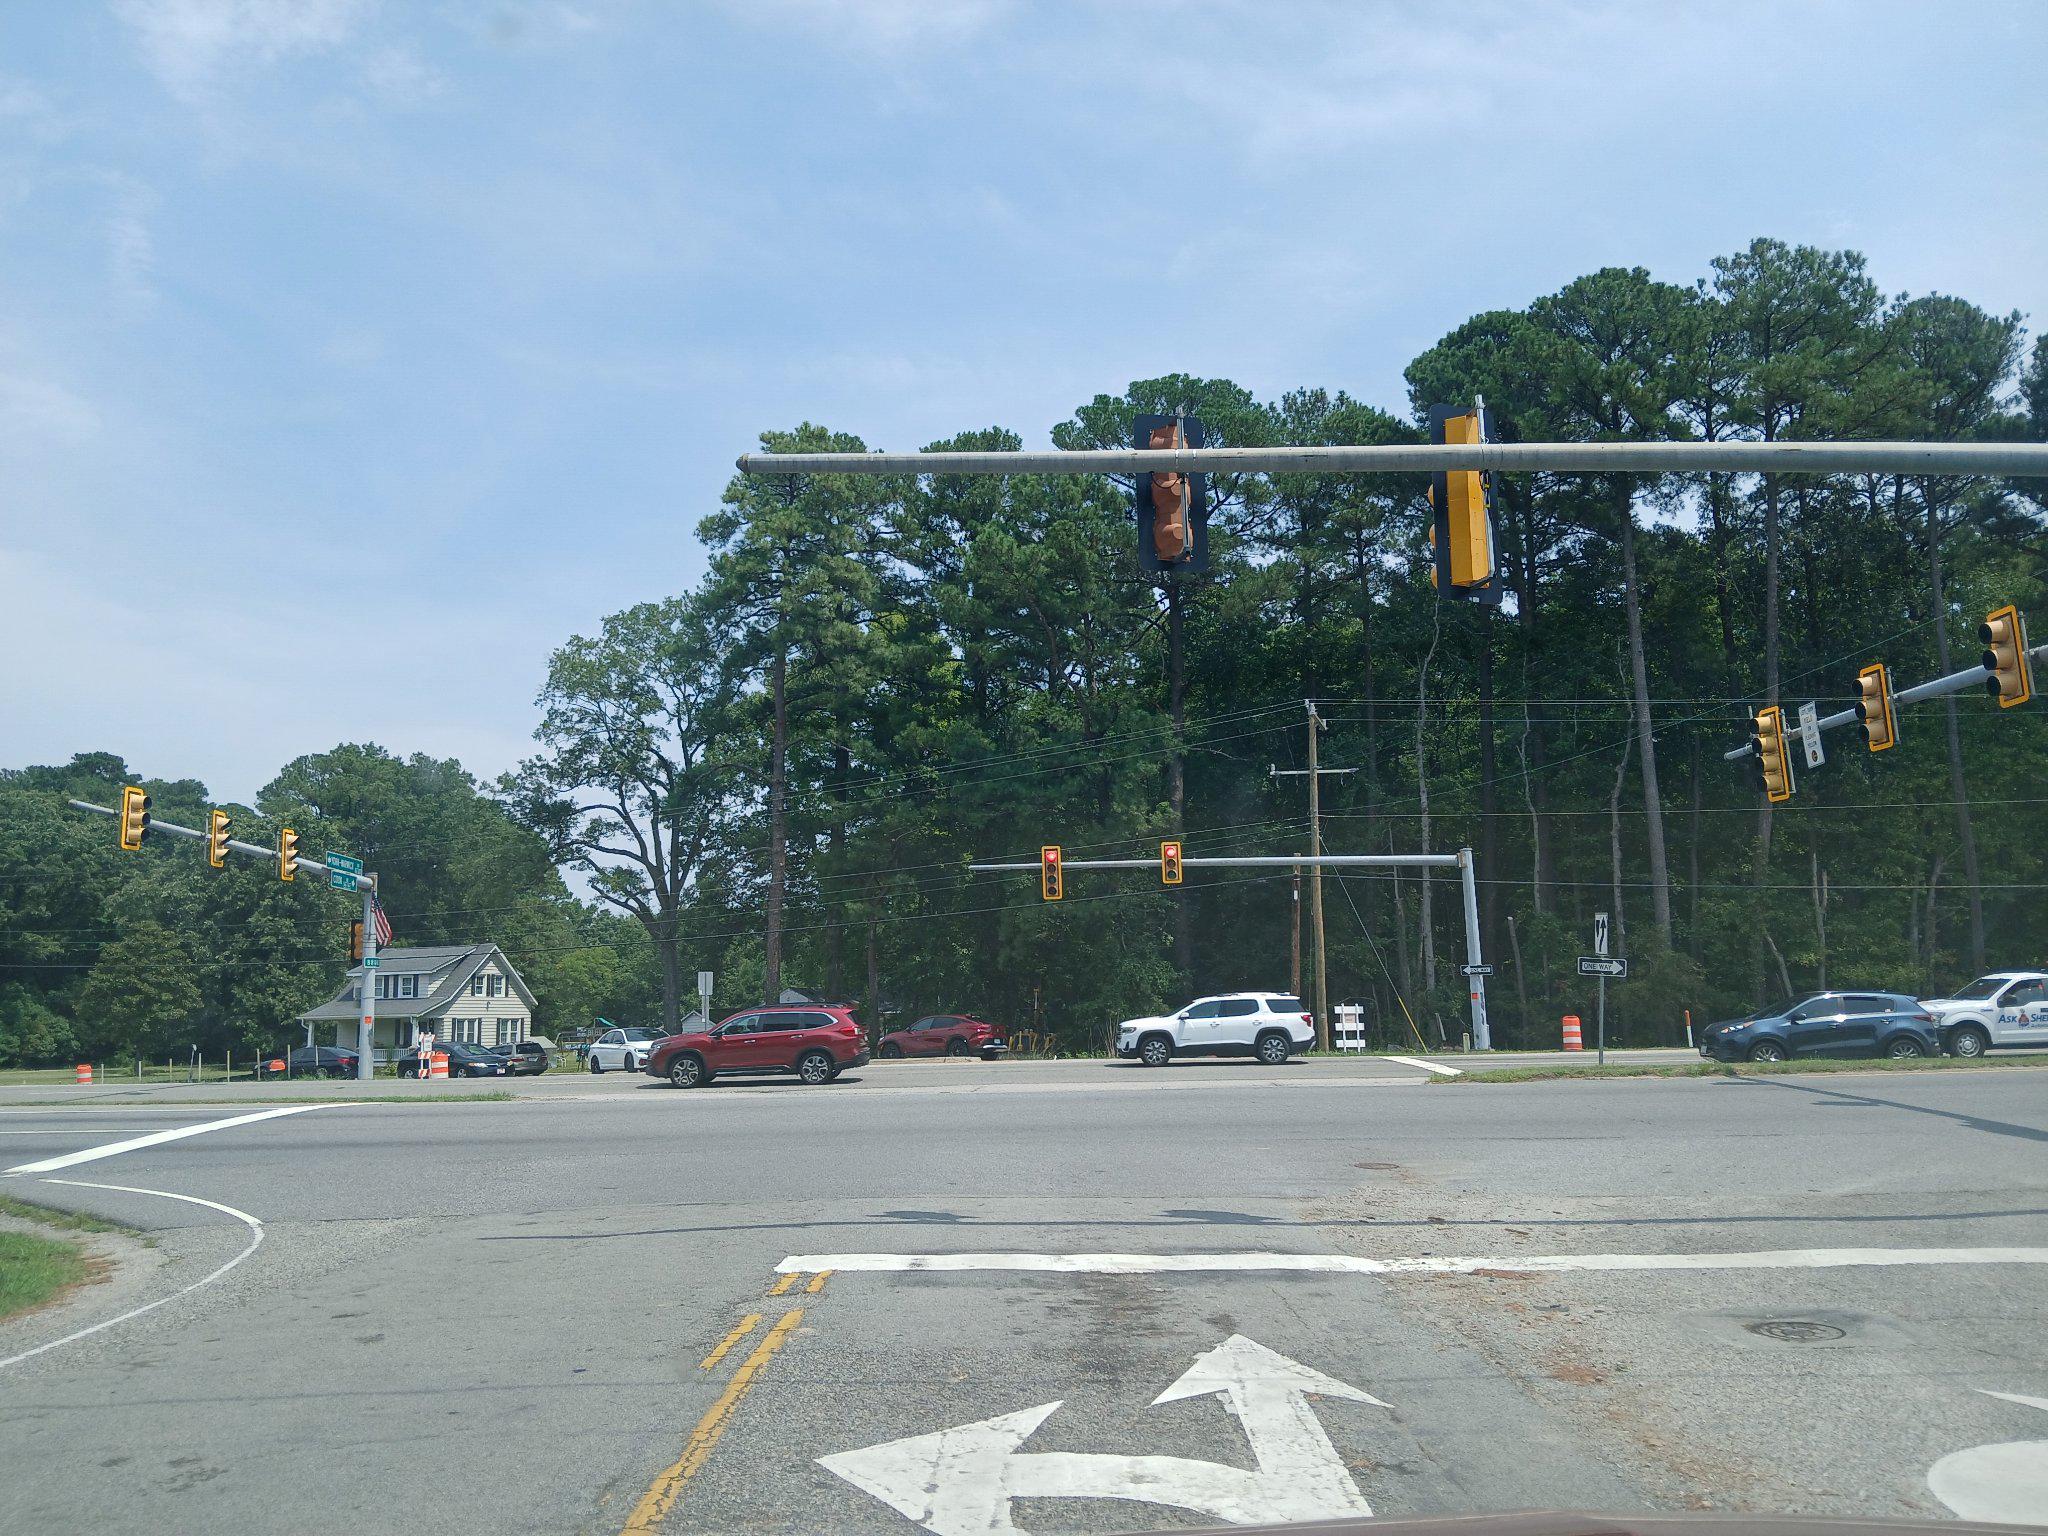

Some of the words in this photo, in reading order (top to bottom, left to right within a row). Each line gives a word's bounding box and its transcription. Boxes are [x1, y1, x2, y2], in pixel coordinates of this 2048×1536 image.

[1583, 962, 1597, 970] ONE
[1599, 963, 1612, 971] WAY
[1998, 1014, 2017, 1023] ASK
[2030, 1013, 2048, 1022] SHE
